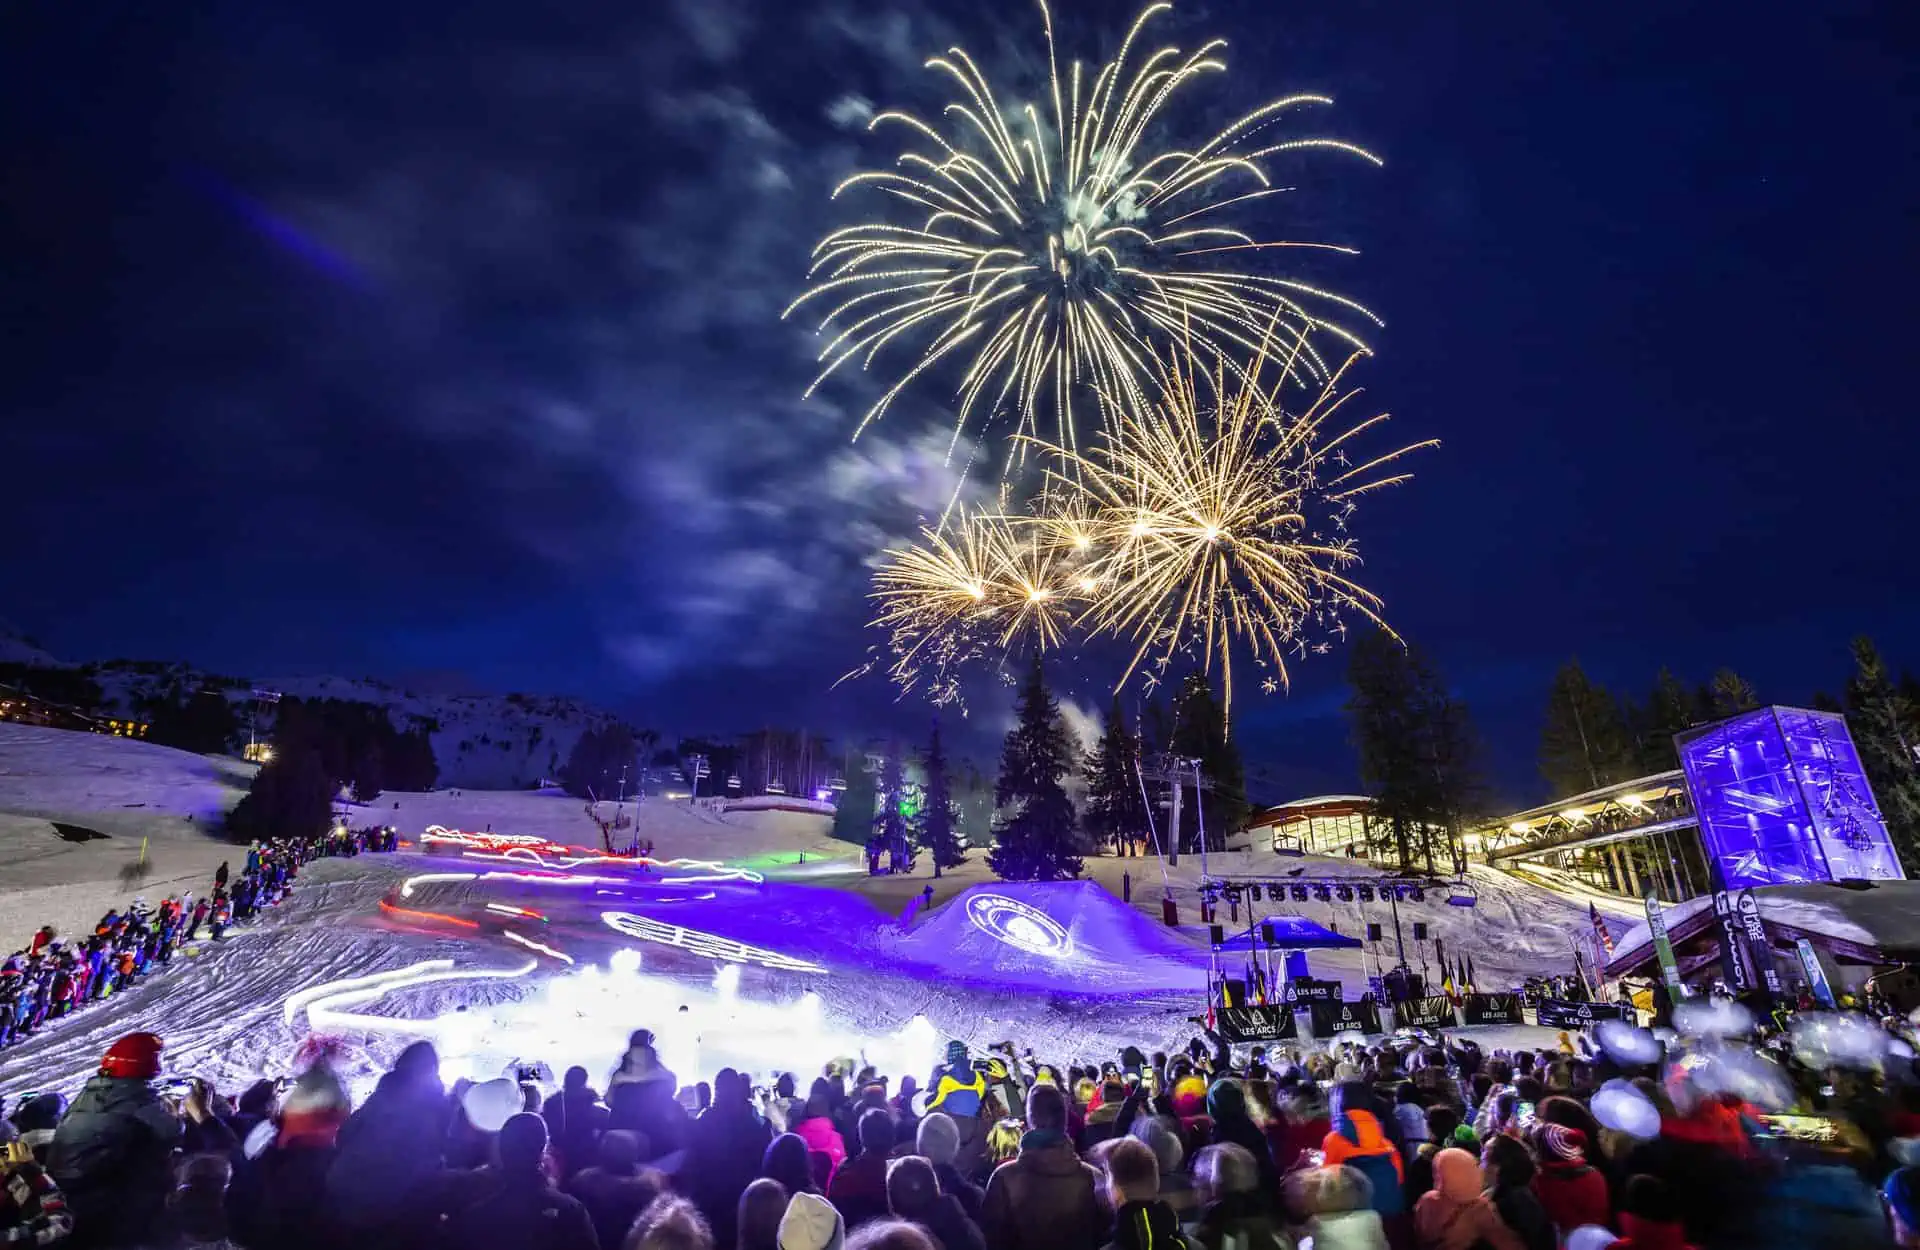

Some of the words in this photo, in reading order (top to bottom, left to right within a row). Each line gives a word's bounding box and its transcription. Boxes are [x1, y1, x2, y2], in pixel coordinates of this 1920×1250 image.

[1241, 1026, 1255, 1036] LES
[1256, 1025, 1277, 1035] ARCS
[1333, 1022, 1344, 1031] LES
